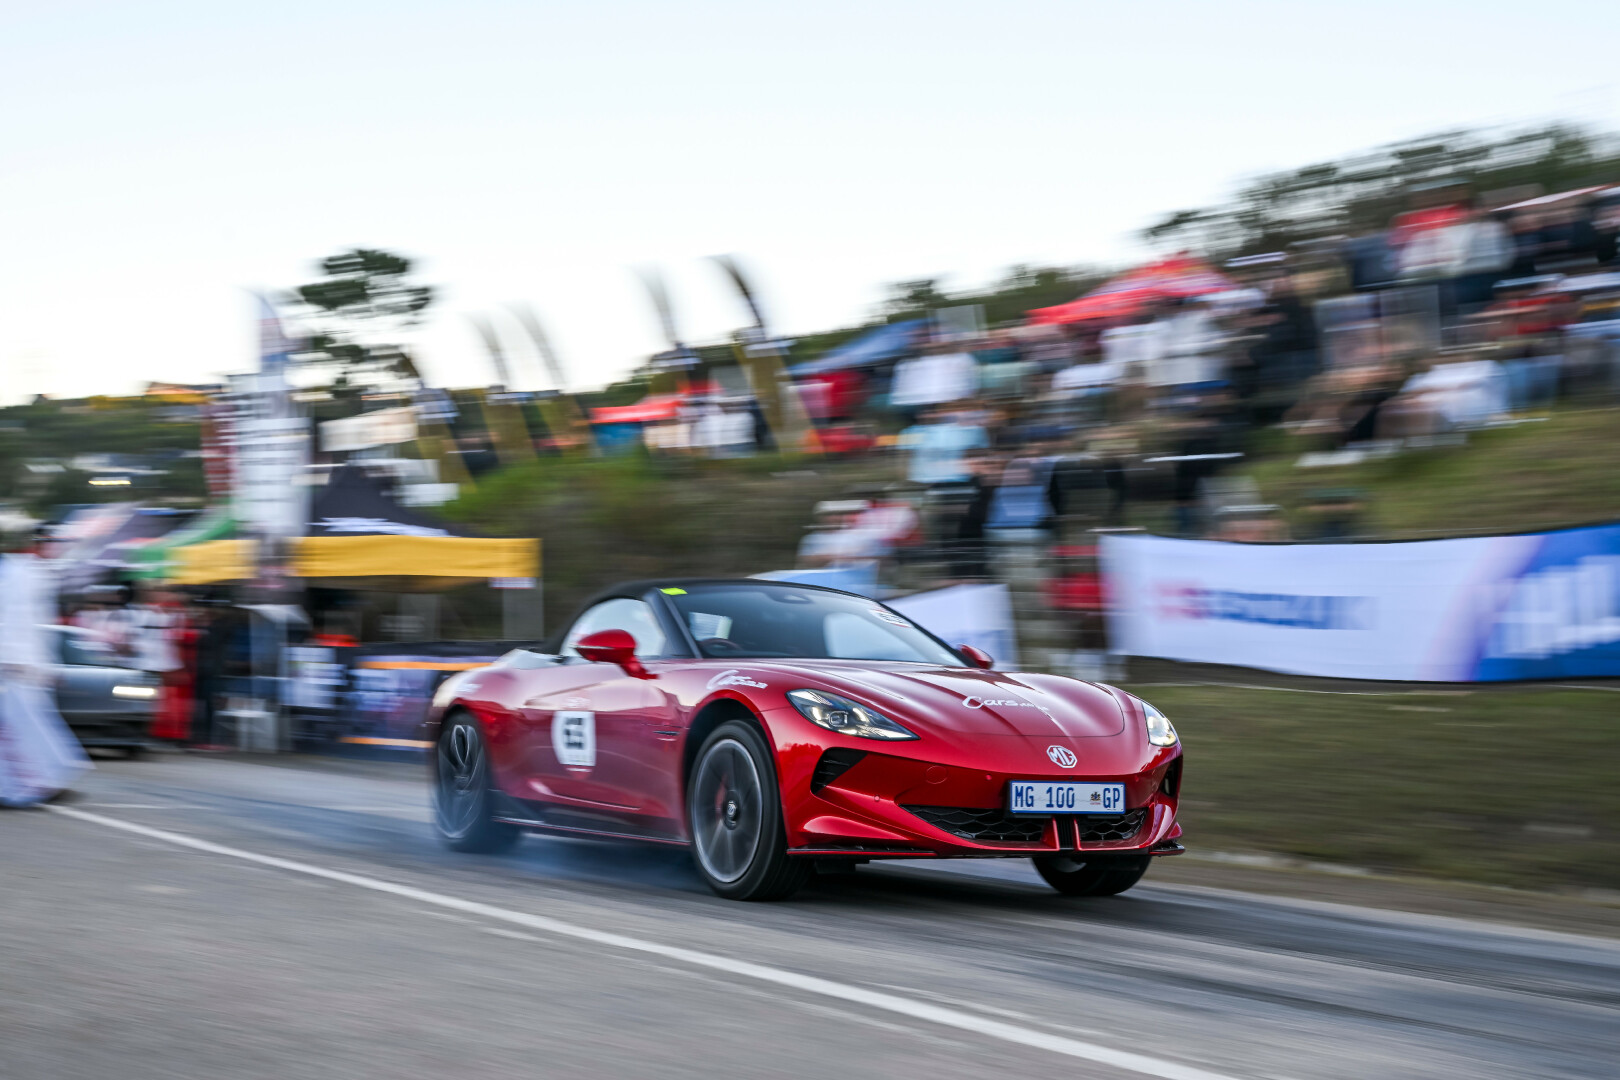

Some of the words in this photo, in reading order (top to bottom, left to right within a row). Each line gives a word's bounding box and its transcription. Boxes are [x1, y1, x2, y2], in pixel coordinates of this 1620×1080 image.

[1048, 746, 1076, 767] MG
[1014, 785, 1034, 808] MG
[1045, 786, 1075, 809] 100
[1103, 787, 1120, 809] GP
